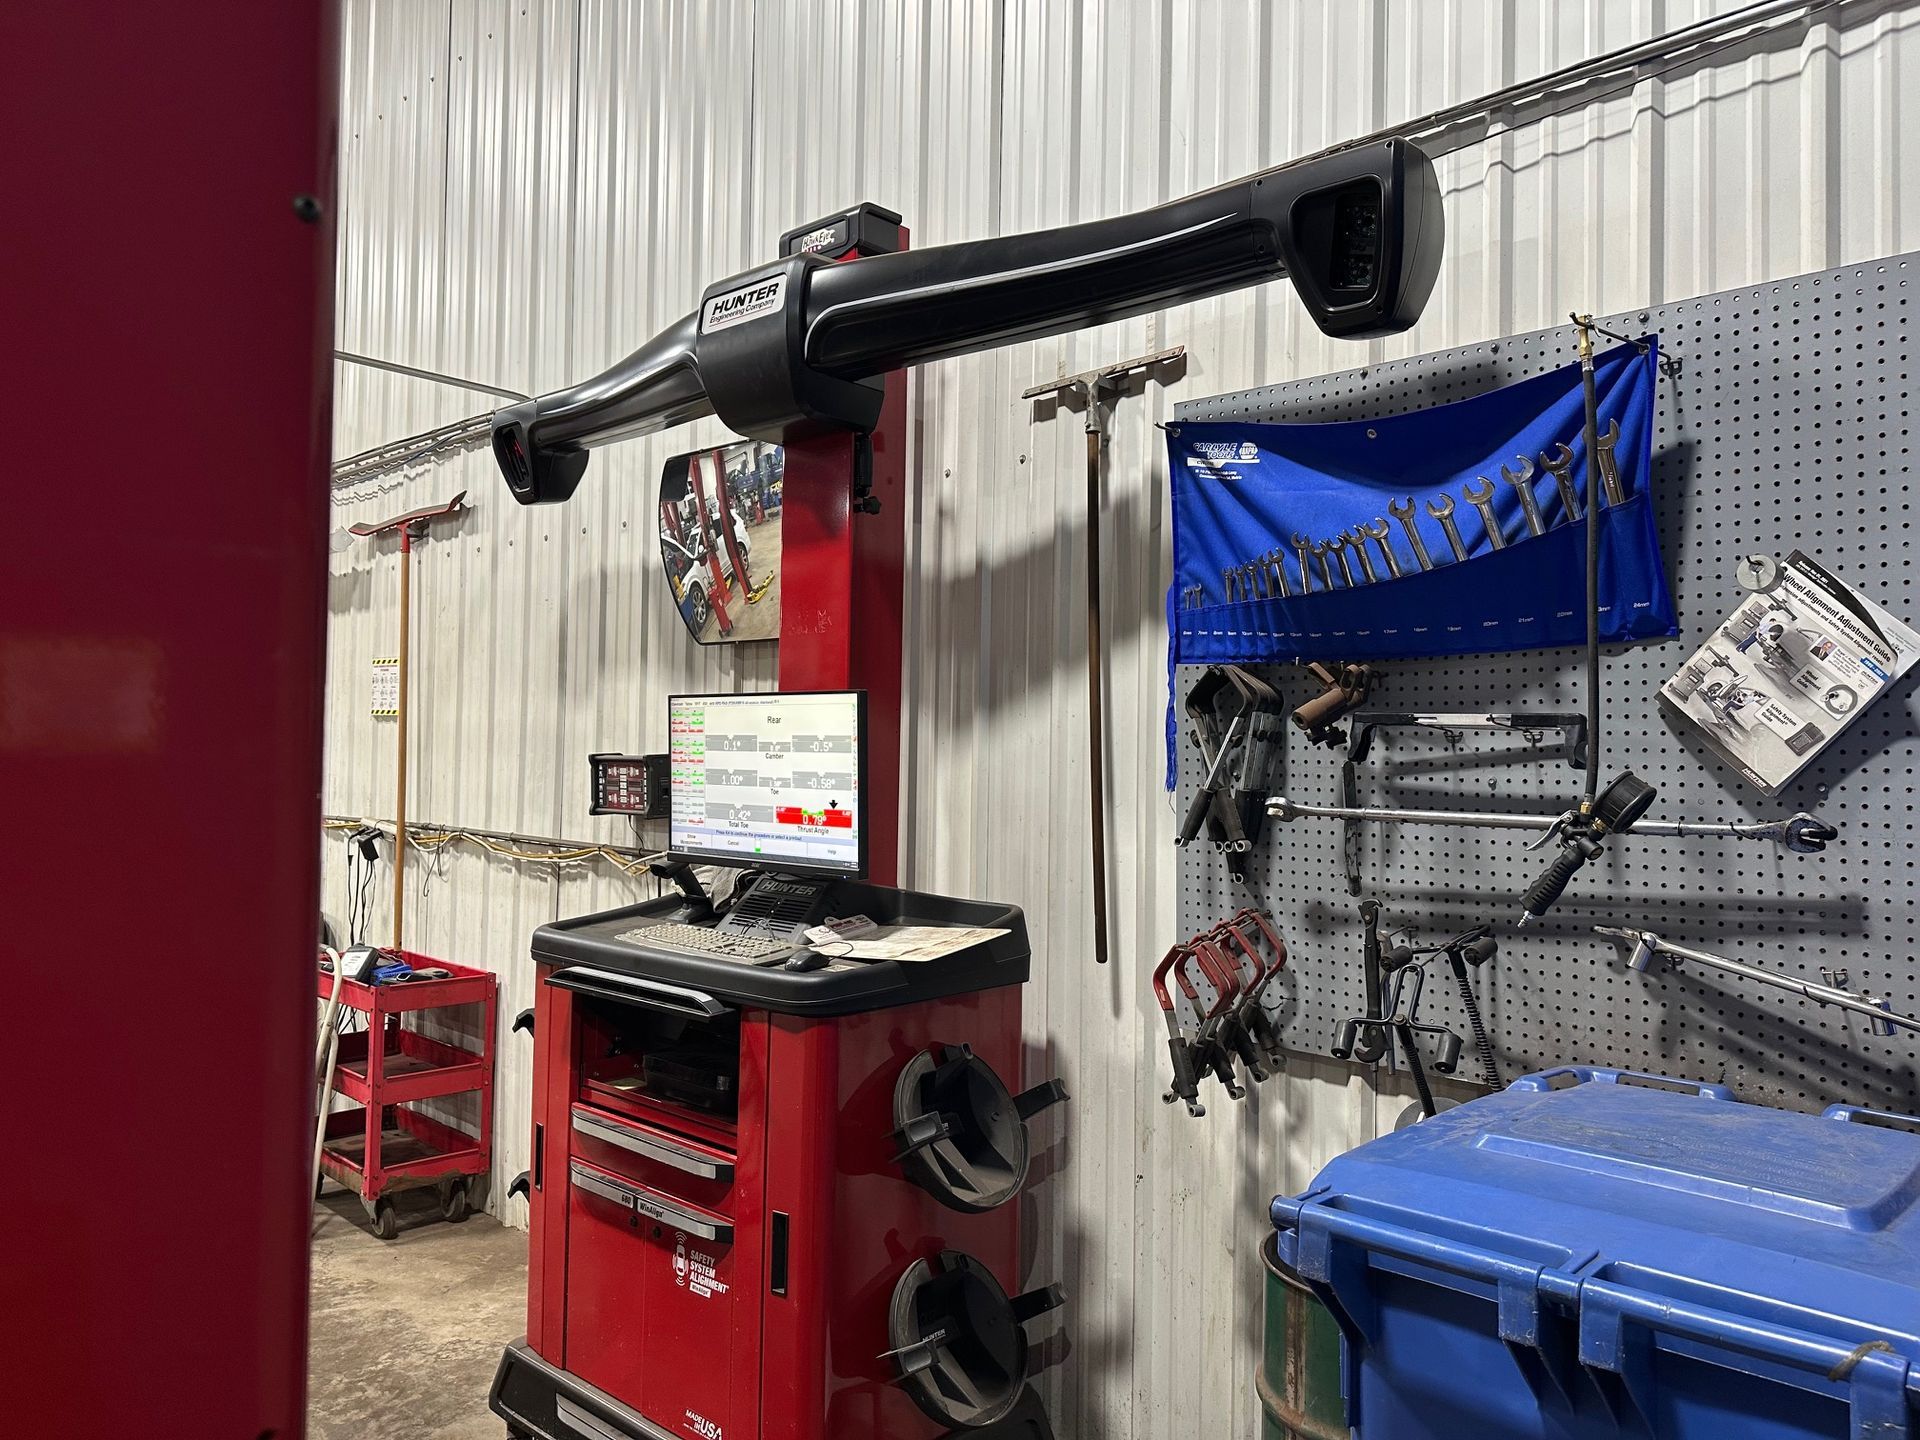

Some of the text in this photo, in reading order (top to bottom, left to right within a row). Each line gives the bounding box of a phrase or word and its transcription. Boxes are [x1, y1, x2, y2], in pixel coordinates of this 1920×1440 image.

[712, 282, 779, 316] HUNTER
[710, 298, 775, 324] Engineering Company
[1193, 442, 1238, 452] CARLYLE
[1785, 573, 1805, 593] Wheel
[1803, 590, 1840, 618] Alignment
[1838, 615, 1875, 648] Adjustment
[1873, 643, 1891, 663] Guide
[1820, 614, 1828, 622] and
[1828, 619, 1841, 632] Safety
[1840, 628, 1854, 641] System
[767, 716, 782, 724] Rear
[1761, 711, 1773, 723] Guide
[1769, 703, 1797, 727] Safety System
[1742, 767, 1767, 787] HUNTER
[797, 825, 829, 835] Thrust Angle
[761, 881, 817, 896] HUNTER
[690, 1249, 715, 1267] SAFETY
[690, 1260, 716, 1279] SYSTEM
[685, 1409, 702, 1424] MADE
[693, 1422, 701, 1431] IN
[700, 1418, 722, 1440] USA
